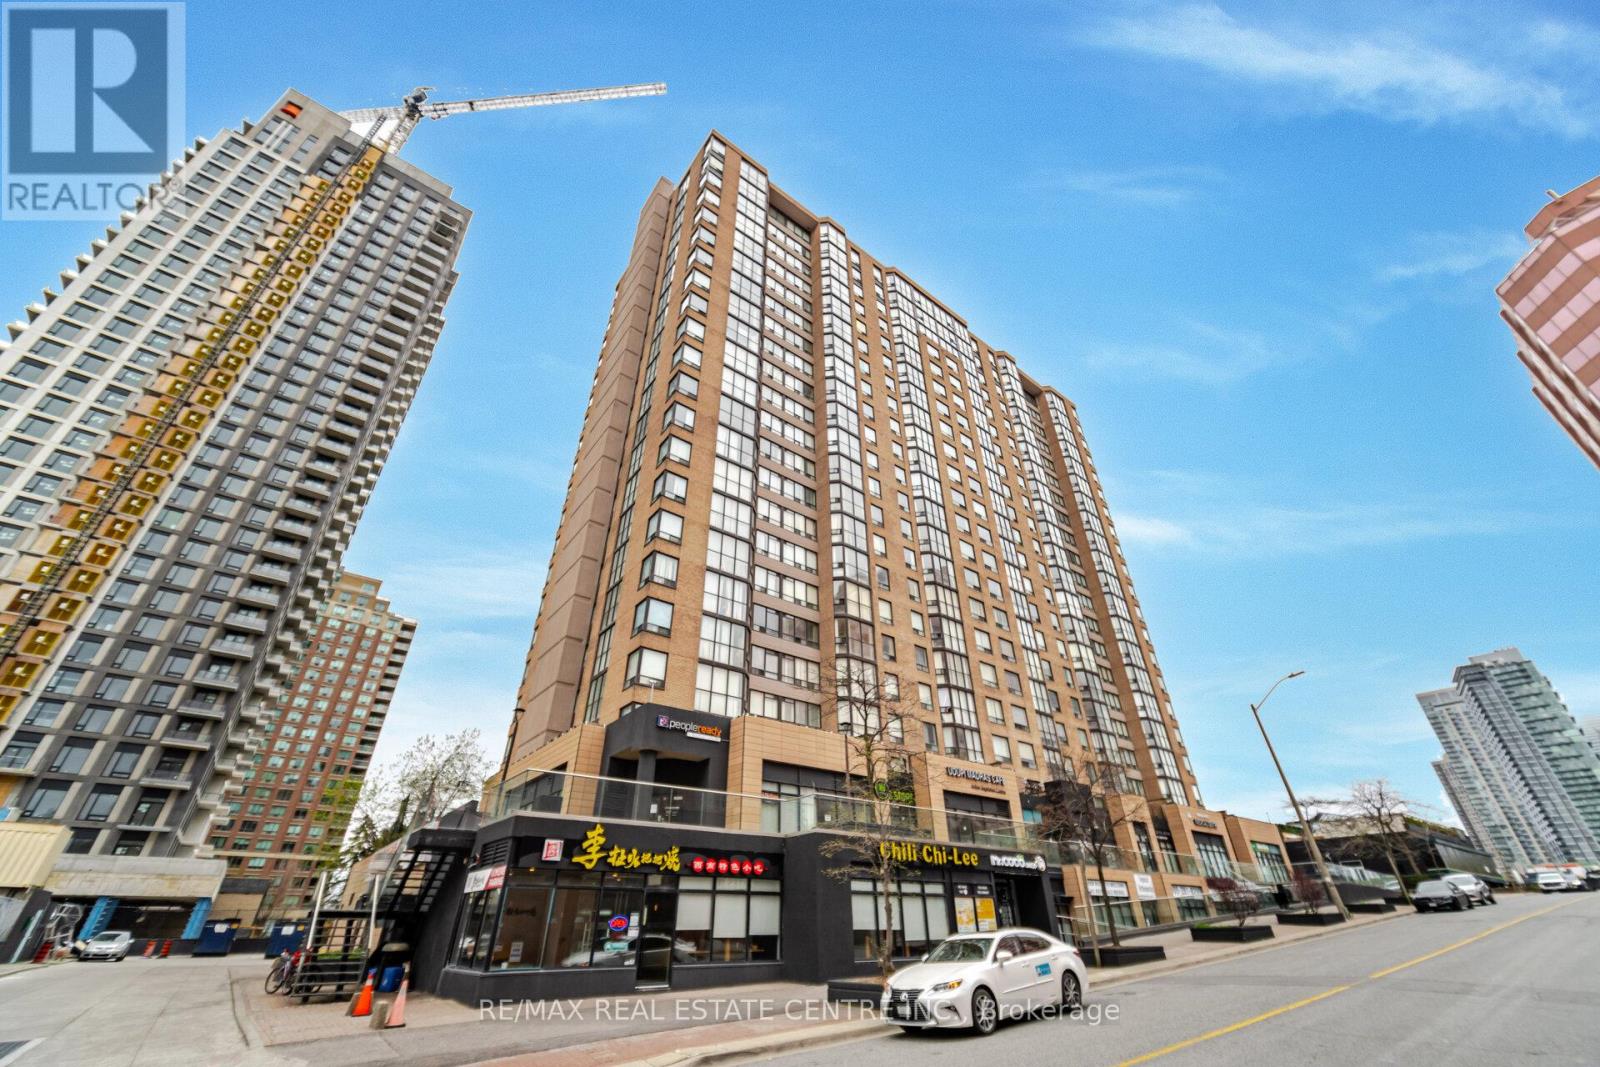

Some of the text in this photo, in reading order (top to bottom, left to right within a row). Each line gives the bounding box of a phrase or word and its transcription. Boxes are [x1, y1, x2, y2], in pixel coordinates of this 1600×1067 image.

[669, 719, 722, 737] peopleready
[880, 840, 979, 866] Chili Chi-Lee
